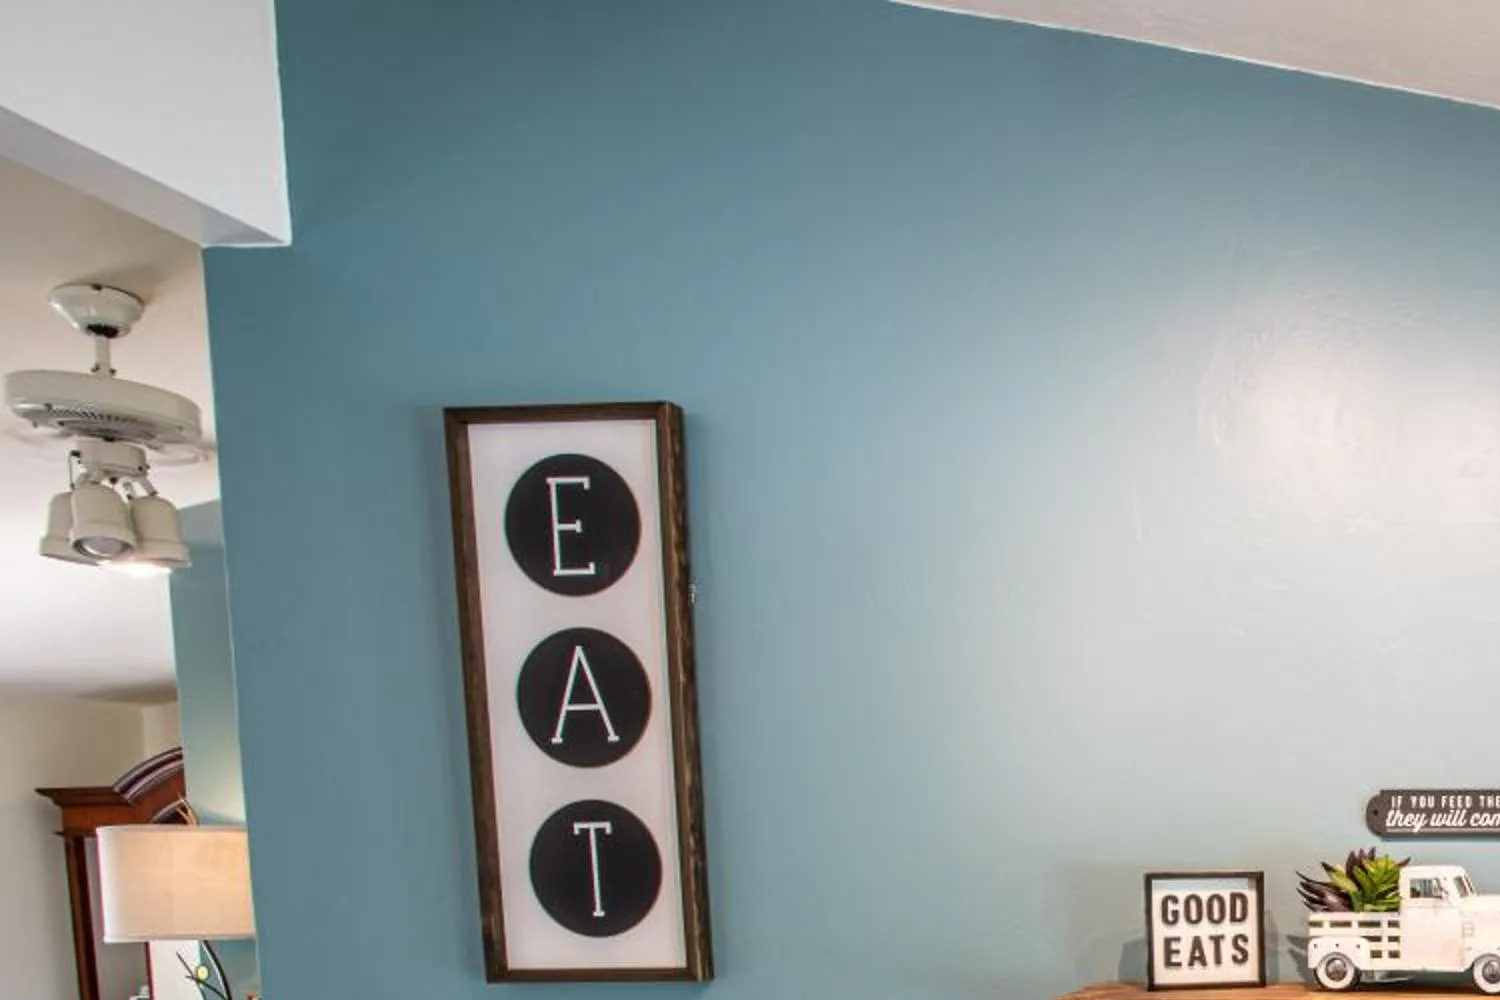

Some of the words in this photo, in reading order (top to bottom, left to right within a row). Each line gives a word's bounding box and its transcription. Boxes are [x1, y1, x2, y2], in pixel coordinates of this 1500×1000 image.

[545, 476, 620, 918] EAT
[1391, 795, 1403, 809] IF
[1411, 795, 1435, 809] YOU
[1441, 795, 1473, 809] FEED
[1385, 809, 1427, 833] they
[1429, 809, 1468, 828] will
[1160, 891, 1249, 926] GOOD
[1163, 933, 1249, 968] EATS
